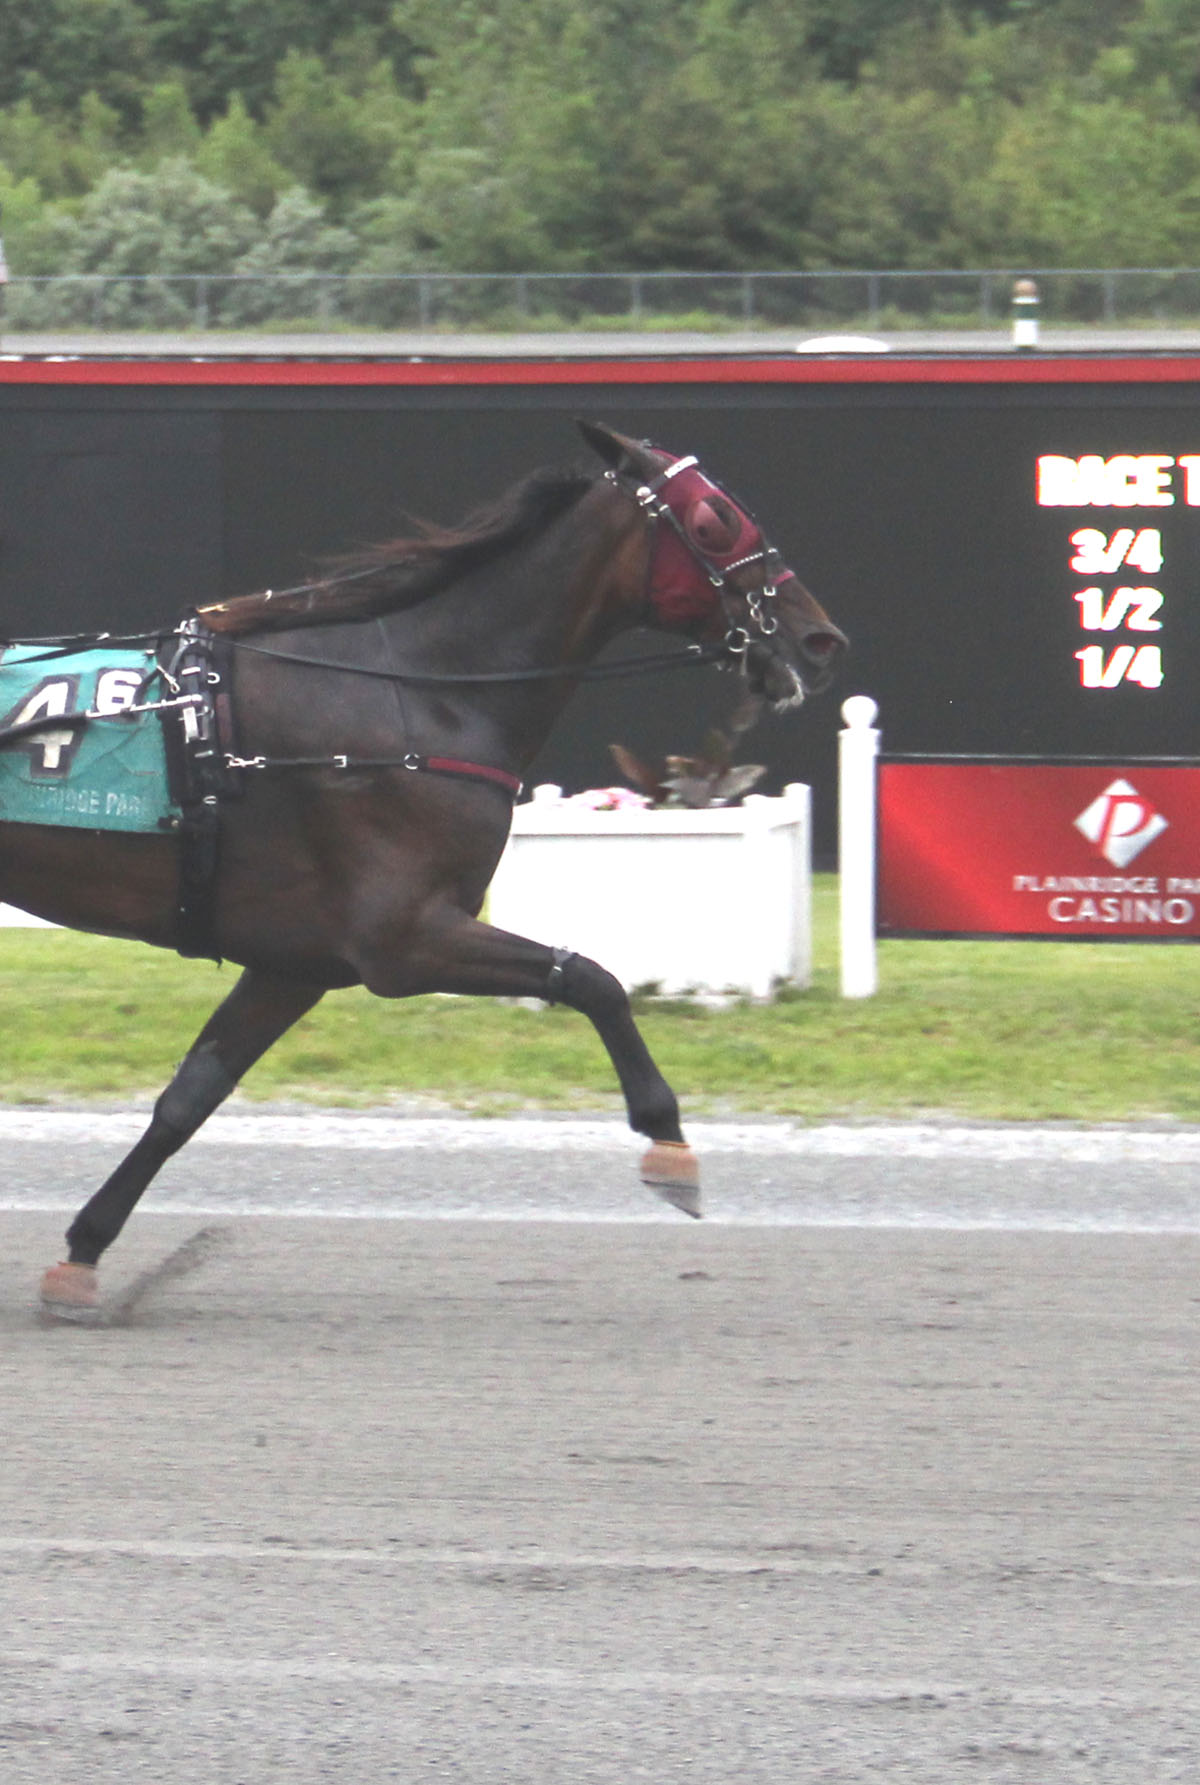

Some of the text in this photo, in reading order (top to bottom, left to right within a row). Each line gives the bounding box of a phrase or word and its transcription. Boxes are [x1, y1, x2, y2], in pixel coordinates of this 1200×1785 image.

[1068, 528, 1164, 574] 3/4
[1072, 586, 1164, 631] 1/2
[1072, 645, 1164, 688] 1/4
[97, 669, 143, 715] 6
[9, 681, 75, 769] 4
[1012, 875, 1159, 894] PLAINRIDGE
[1048, 897, 1194, 924] CASINO
